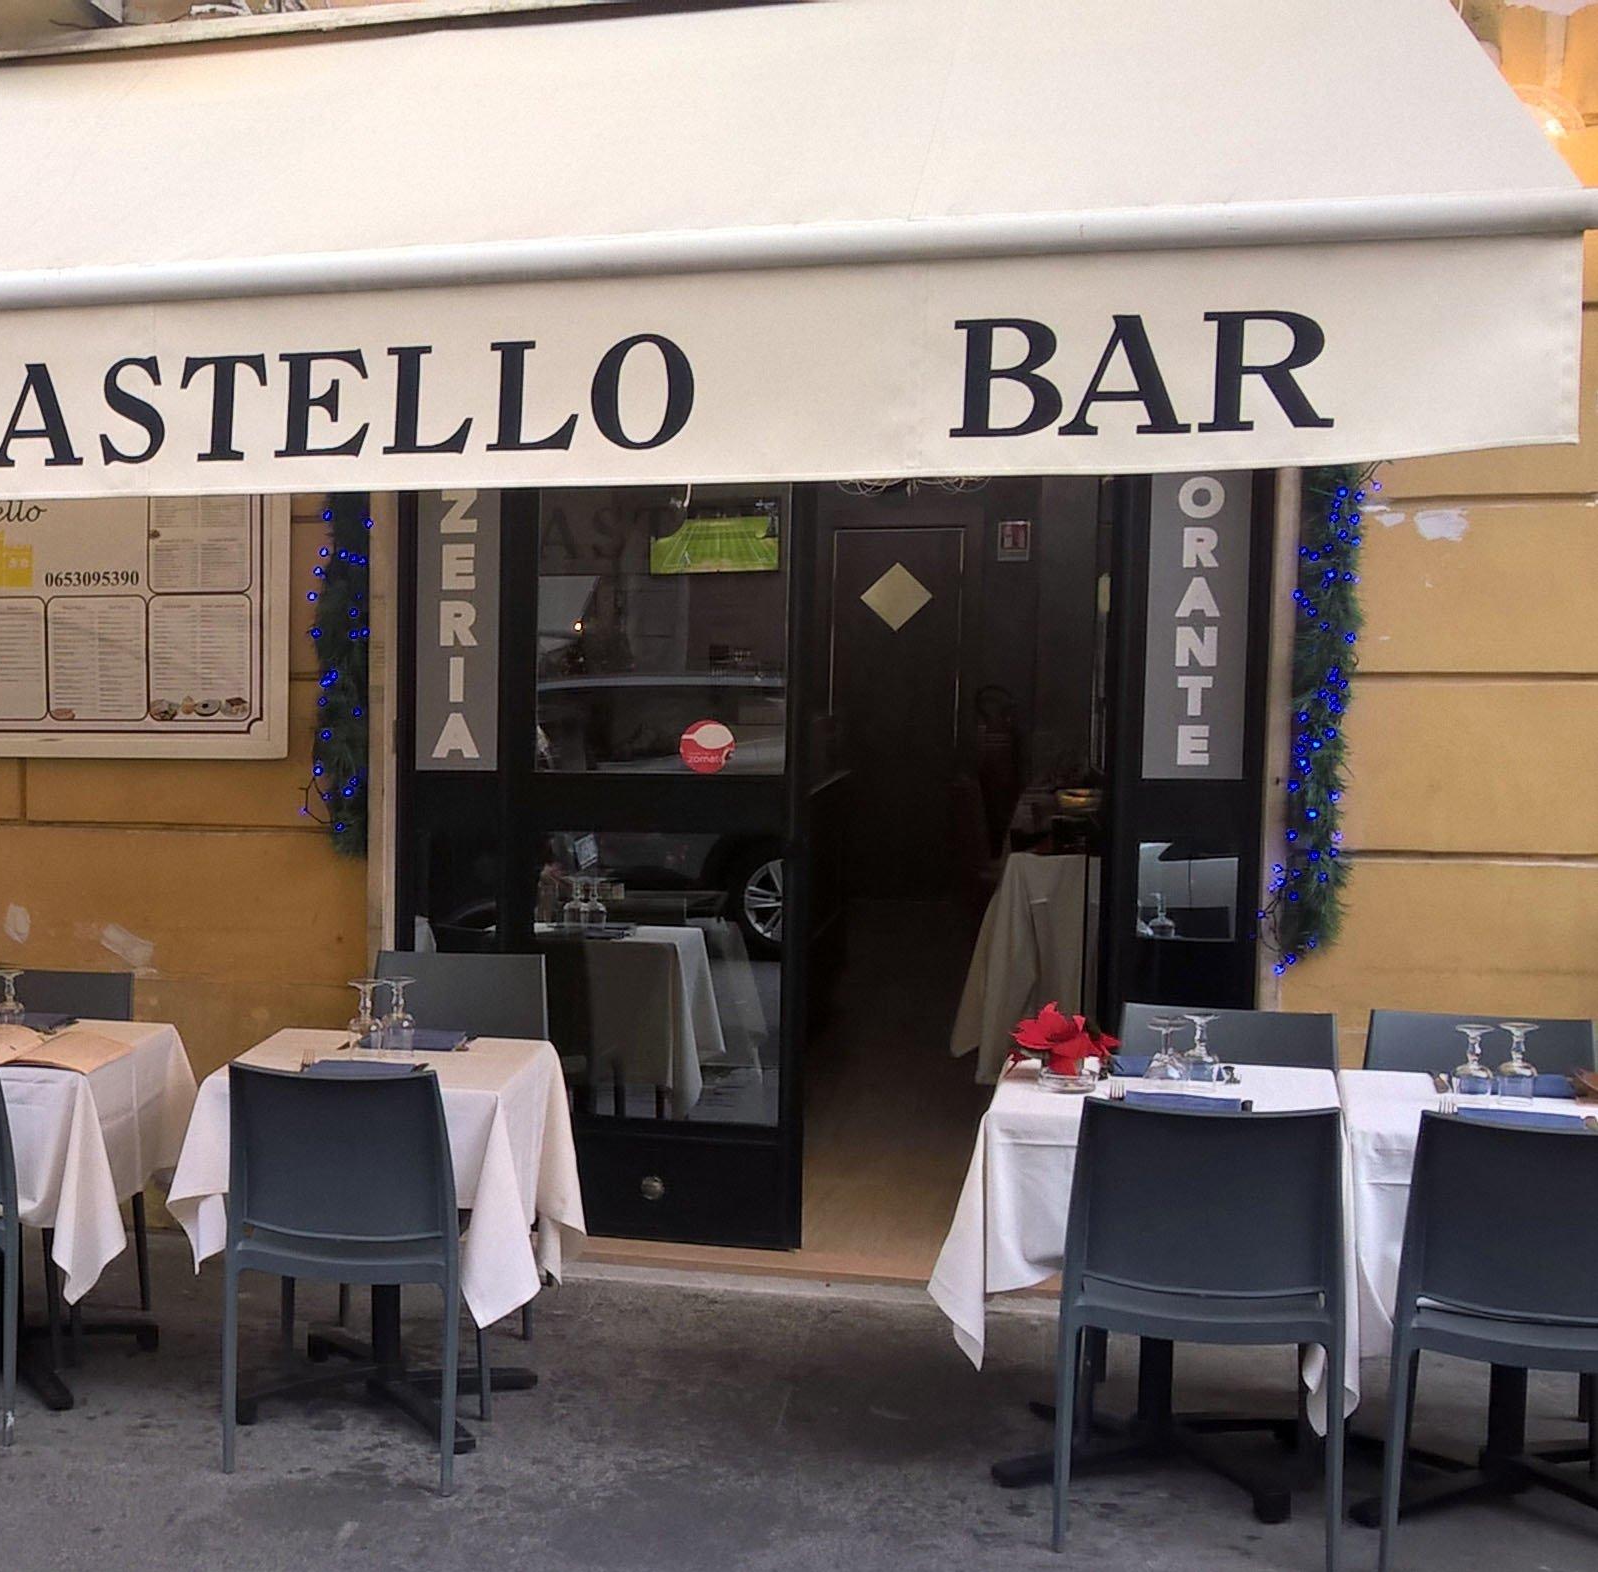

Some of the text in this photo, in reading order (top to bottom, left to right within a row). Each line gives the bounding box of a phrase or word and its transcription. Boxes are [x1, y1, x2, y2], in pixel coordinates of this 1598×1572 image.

[948, 309, 1335, 438] BAR
[44, 571, 140, 587] 0653095390
[430, 488, 481, 759] ZERIA
[1174, 475, 1226, 766] ORANTE
